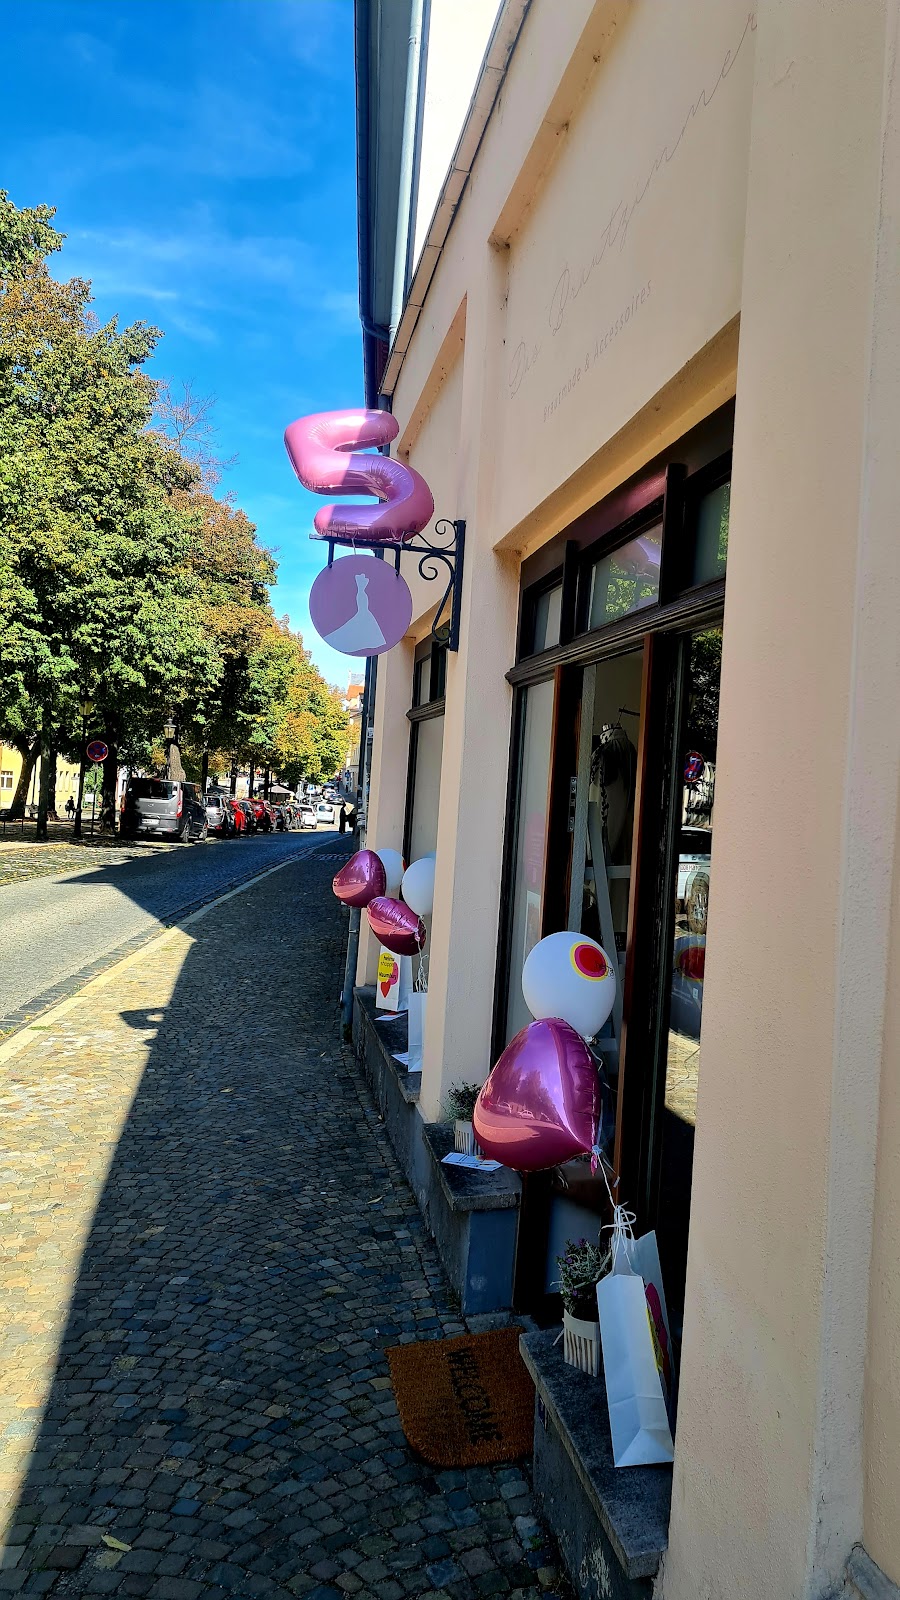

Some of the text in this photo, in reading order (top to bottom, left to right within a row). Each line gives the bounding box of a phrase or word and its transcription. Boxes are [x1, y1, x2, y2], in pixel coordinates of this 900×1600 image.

[543, 279, 651, 423] Brautmode & Accessoires
[447, 1347, 503, 1446] WELCOME
